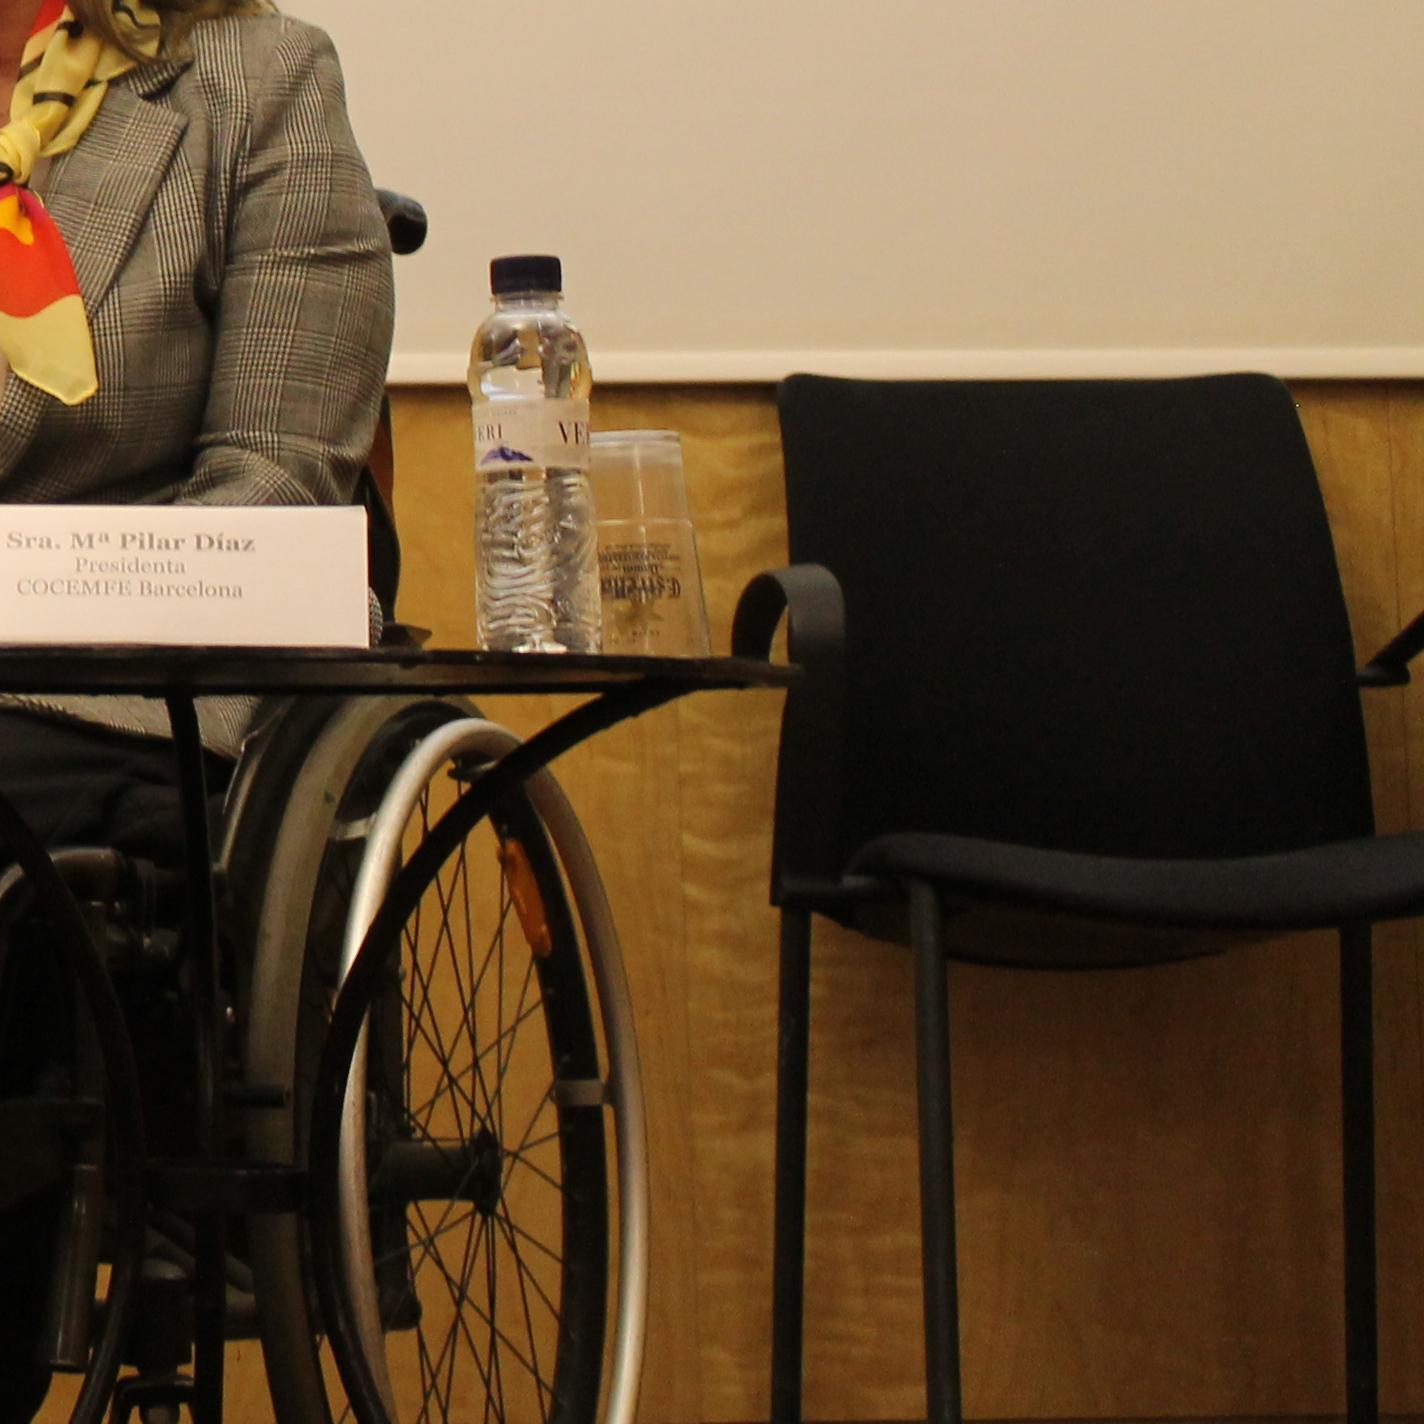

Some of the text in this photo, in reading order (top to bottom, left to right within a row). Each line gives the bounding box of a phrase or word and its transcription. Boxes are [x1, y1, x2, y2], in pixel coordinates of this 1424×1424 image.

[6, 532, 61, 551] Sra.
[120, 531, 186, 551] Pilar
[195, 531, 256, 553] Díaz
[75, 556, 186, 575] Presidenta
[16, 578, 244, 599] COCEMFE Barcelona
